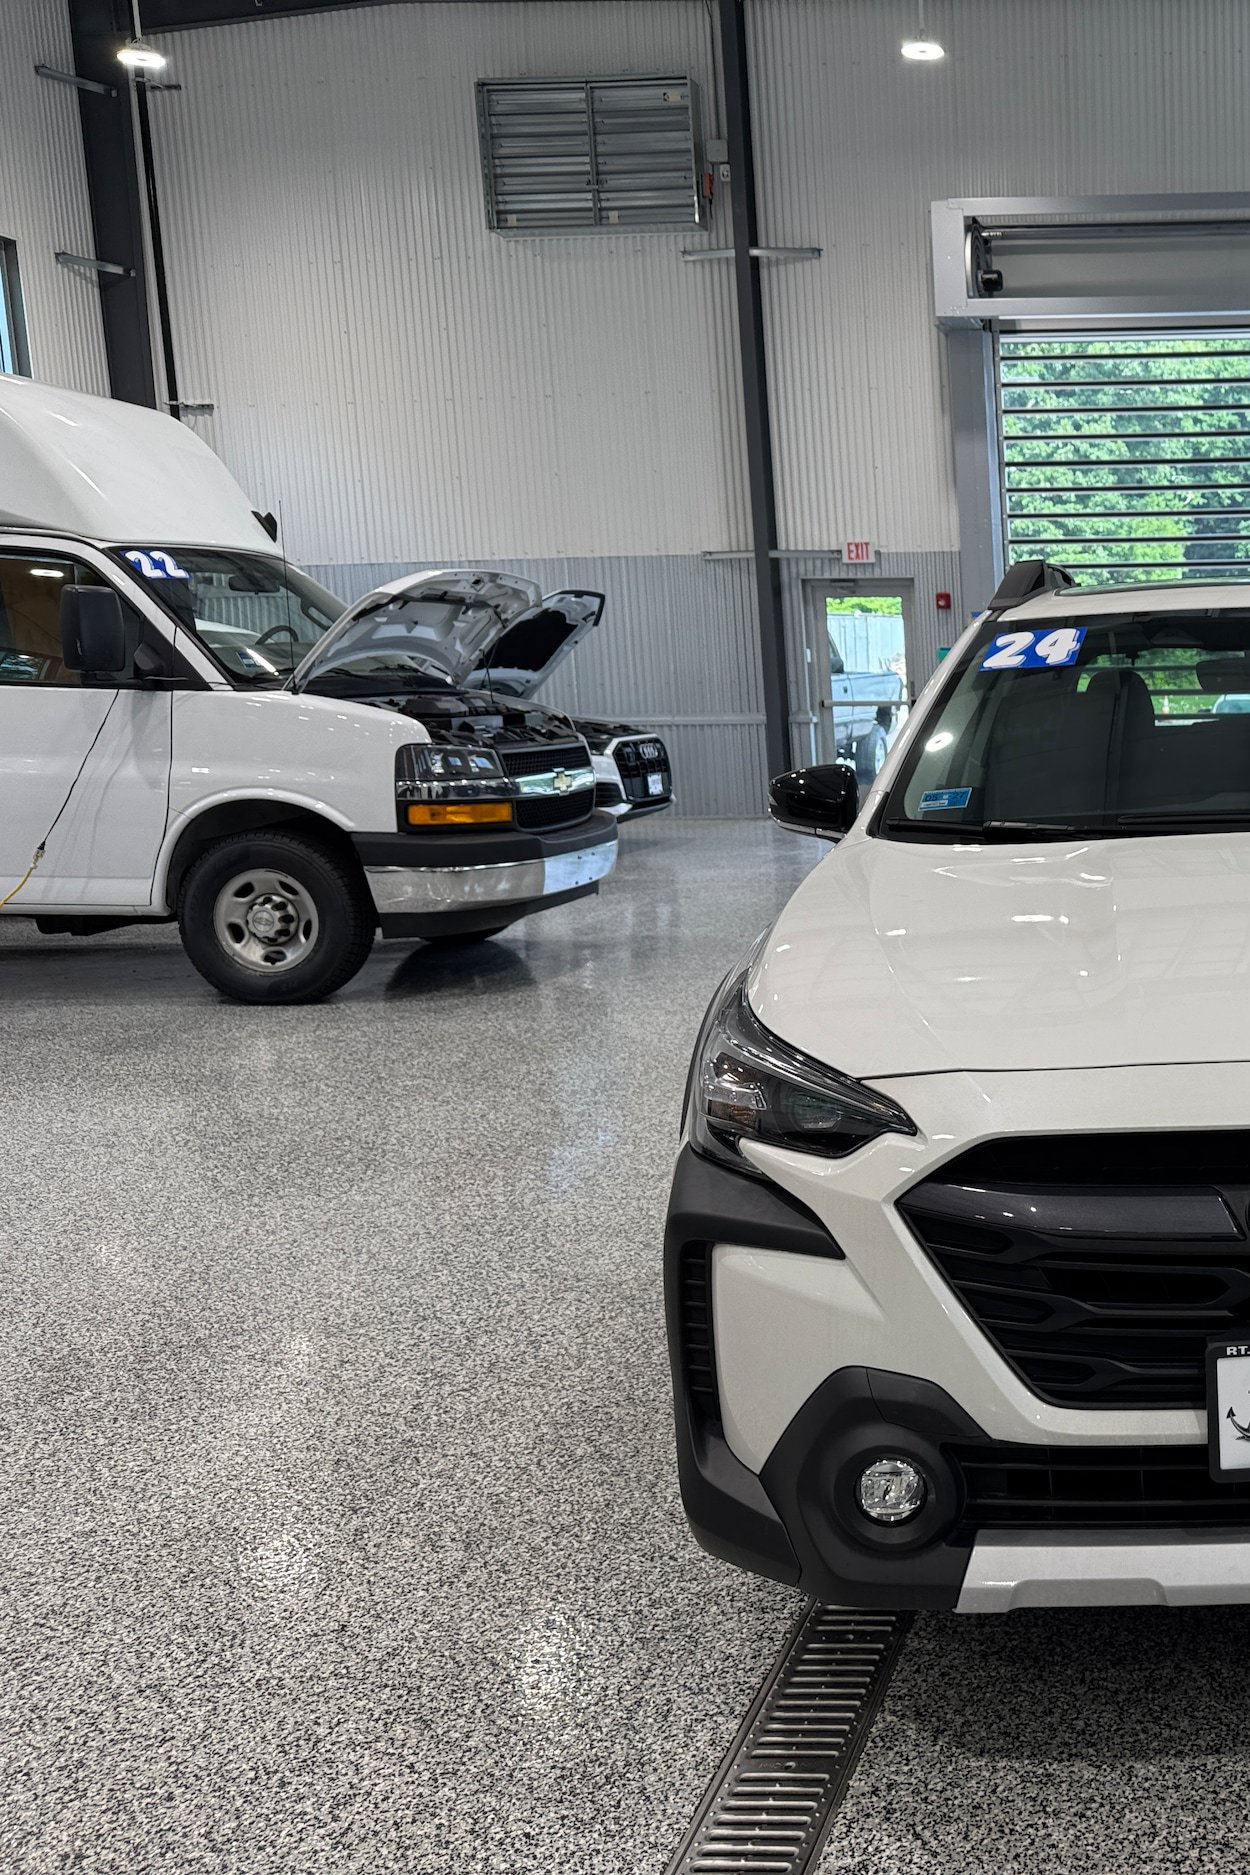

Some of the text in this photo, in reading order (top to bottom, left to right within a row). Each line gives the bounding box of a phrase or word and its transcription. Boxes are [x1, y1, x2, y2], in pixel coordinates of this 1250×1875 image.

[847, 542, 870, 561] EXIT
[125, 550, 190, 578] 22
[983, 628, 1080, 669] 24
[1226, 1345, 1250, 1356] RT.
